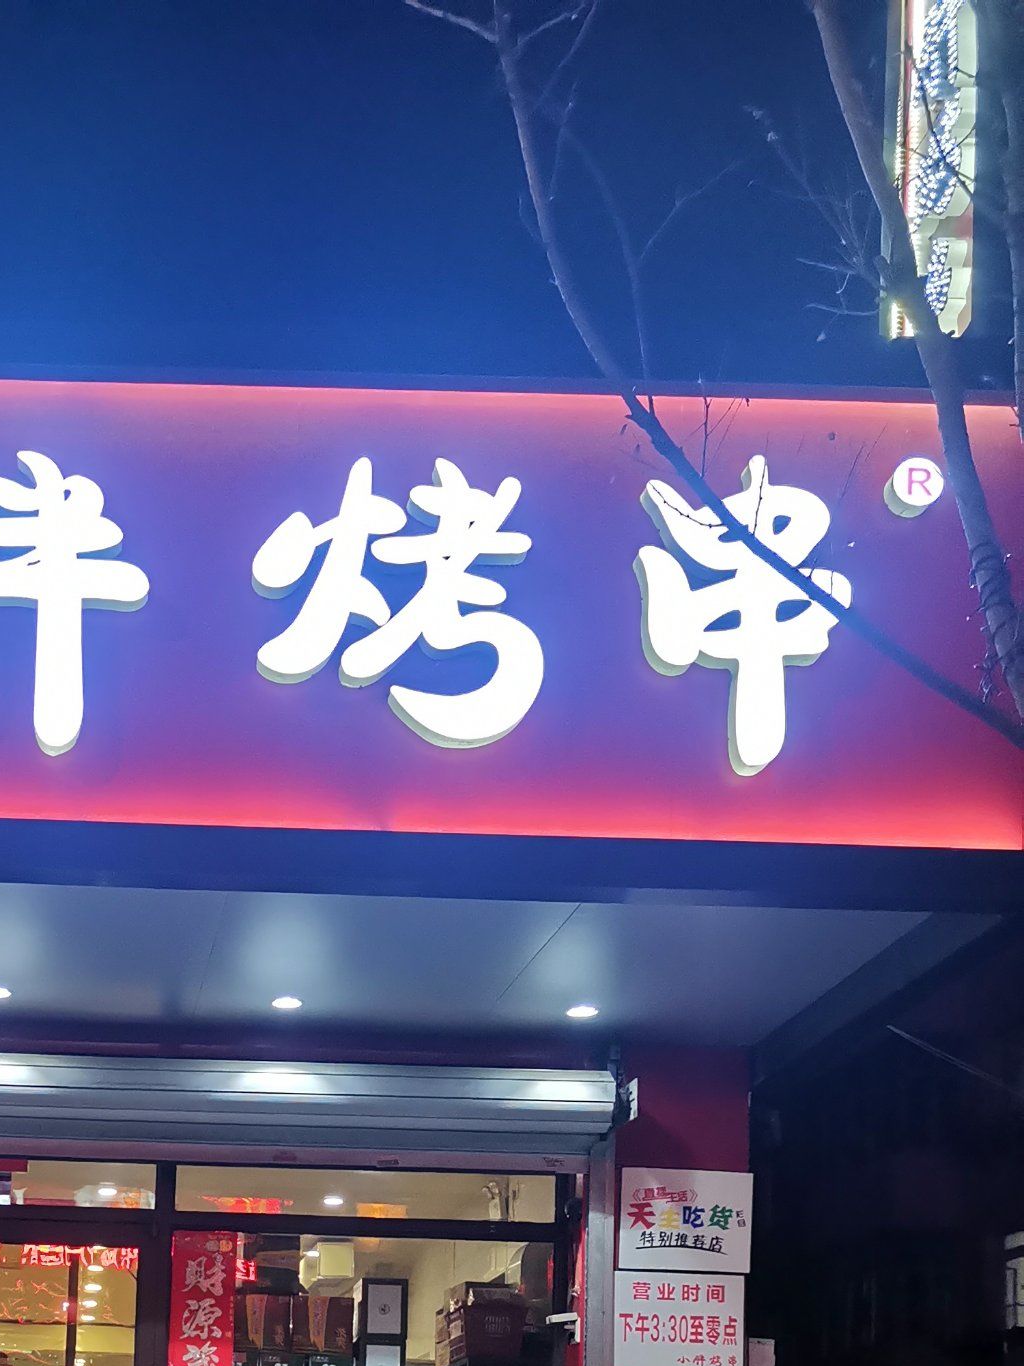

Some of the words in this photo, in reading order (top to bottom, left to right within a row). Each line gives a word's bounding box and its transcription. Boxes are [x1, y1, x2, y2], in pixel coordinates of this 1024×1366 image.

[640, 1231, 724, 1253] 特别推荐店
[632, 1281, 725, 1303] 营业时间
[619, 1312, 738, 1346] 下午3:30至零点
